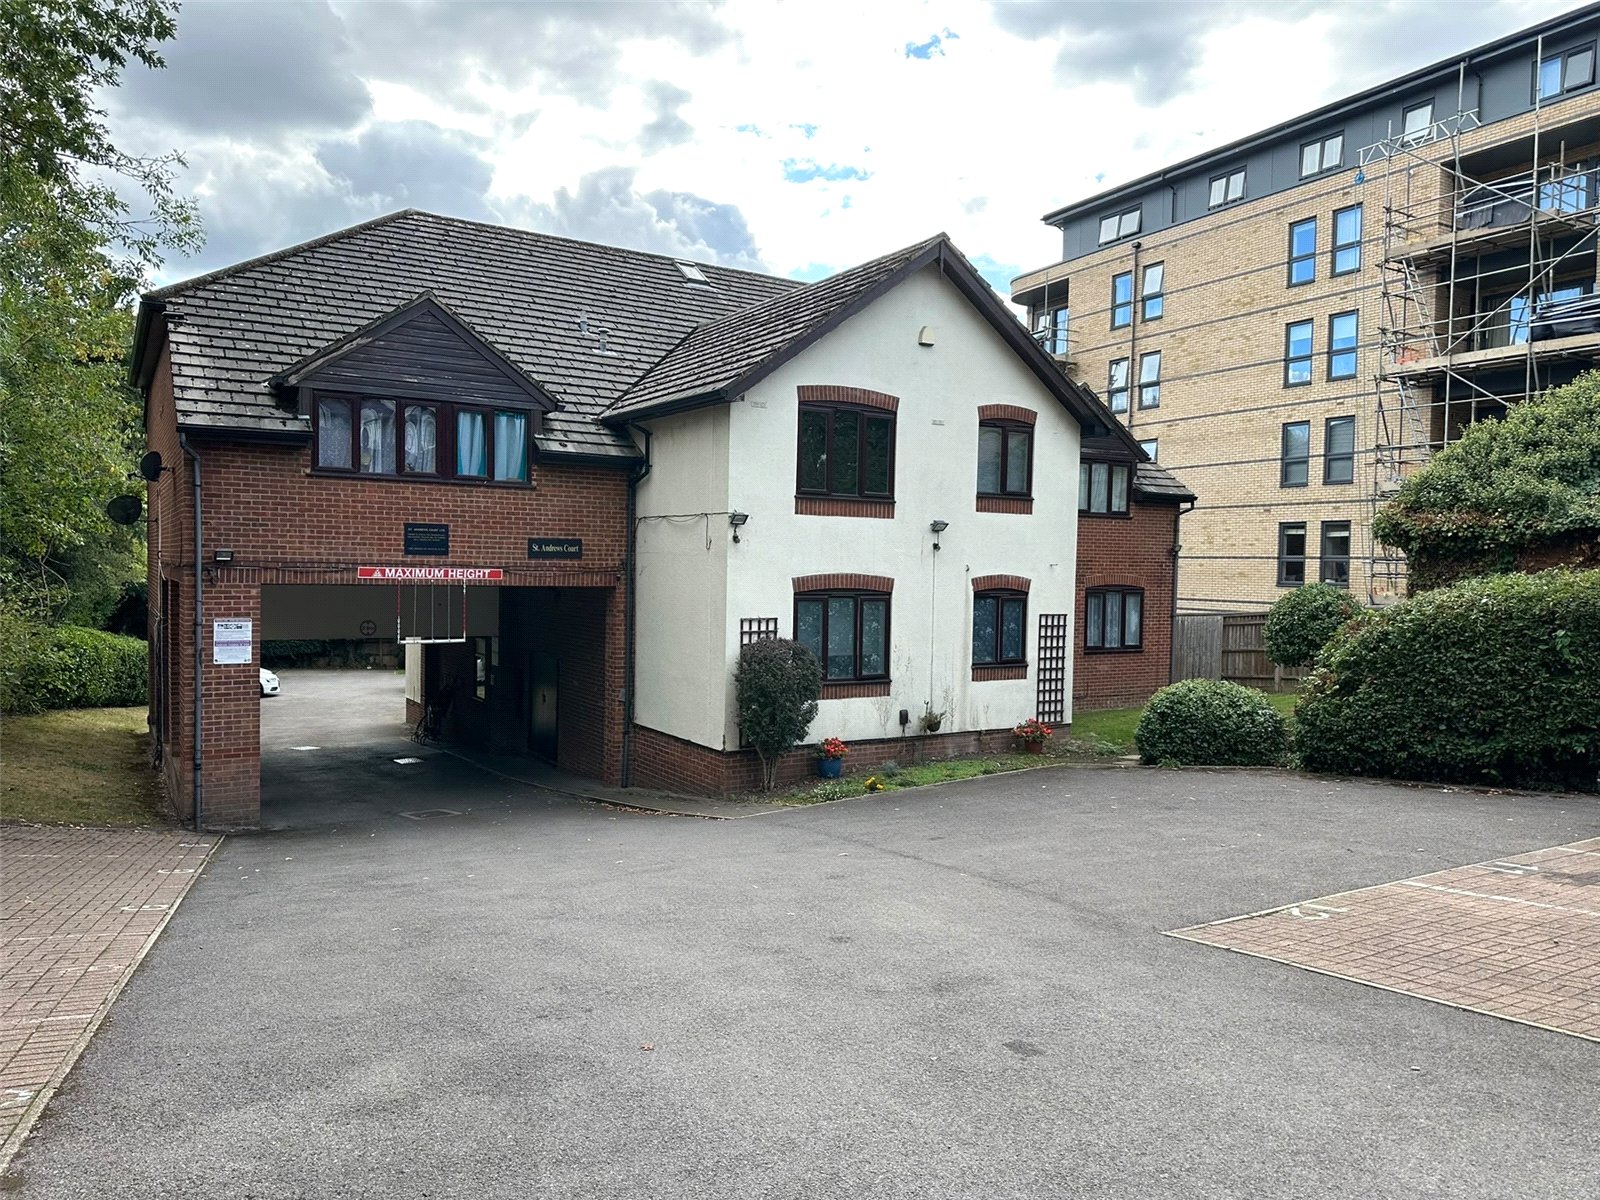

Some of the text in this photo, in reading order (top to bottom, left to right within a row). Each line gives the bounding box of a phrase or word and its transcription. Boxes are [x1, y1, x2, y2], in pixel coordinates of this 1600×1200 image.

[531, 543, 579, 553] St. Andrews Court
[385, 568, 491, 579] MAXIMUM HEIGHT
